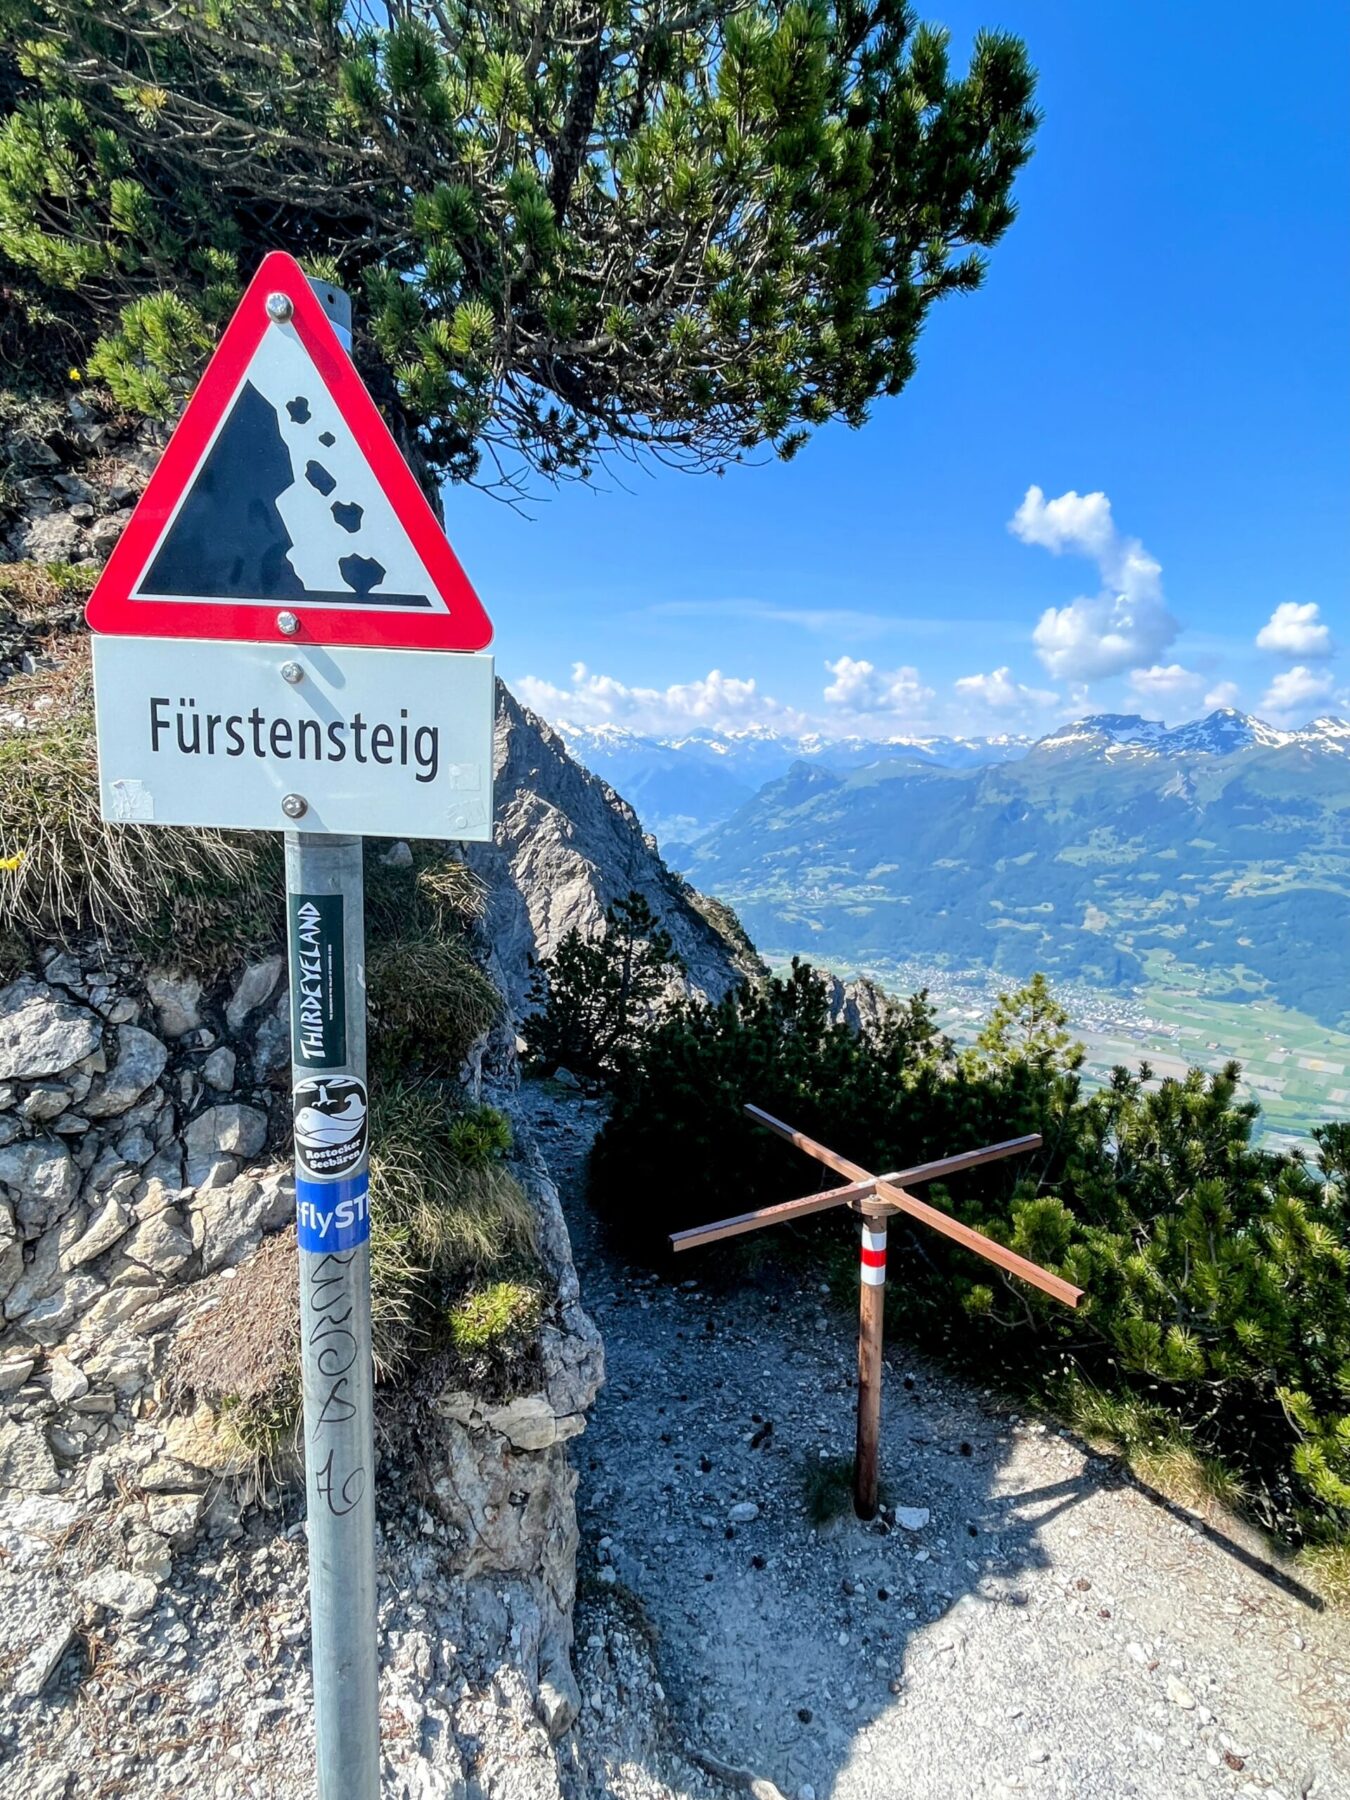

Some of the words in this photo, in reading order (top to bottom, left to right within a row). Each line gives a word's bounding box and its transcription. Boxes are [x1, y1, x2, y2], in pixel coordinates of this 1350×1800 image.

[150, 696, 440, 783] Fürstensteig
[297, 901, 327, 1060] THIRDEYELAND
[305, 1138, 361, 1160] Rostocker
[309, 1149, 361, 1169] Seebären
